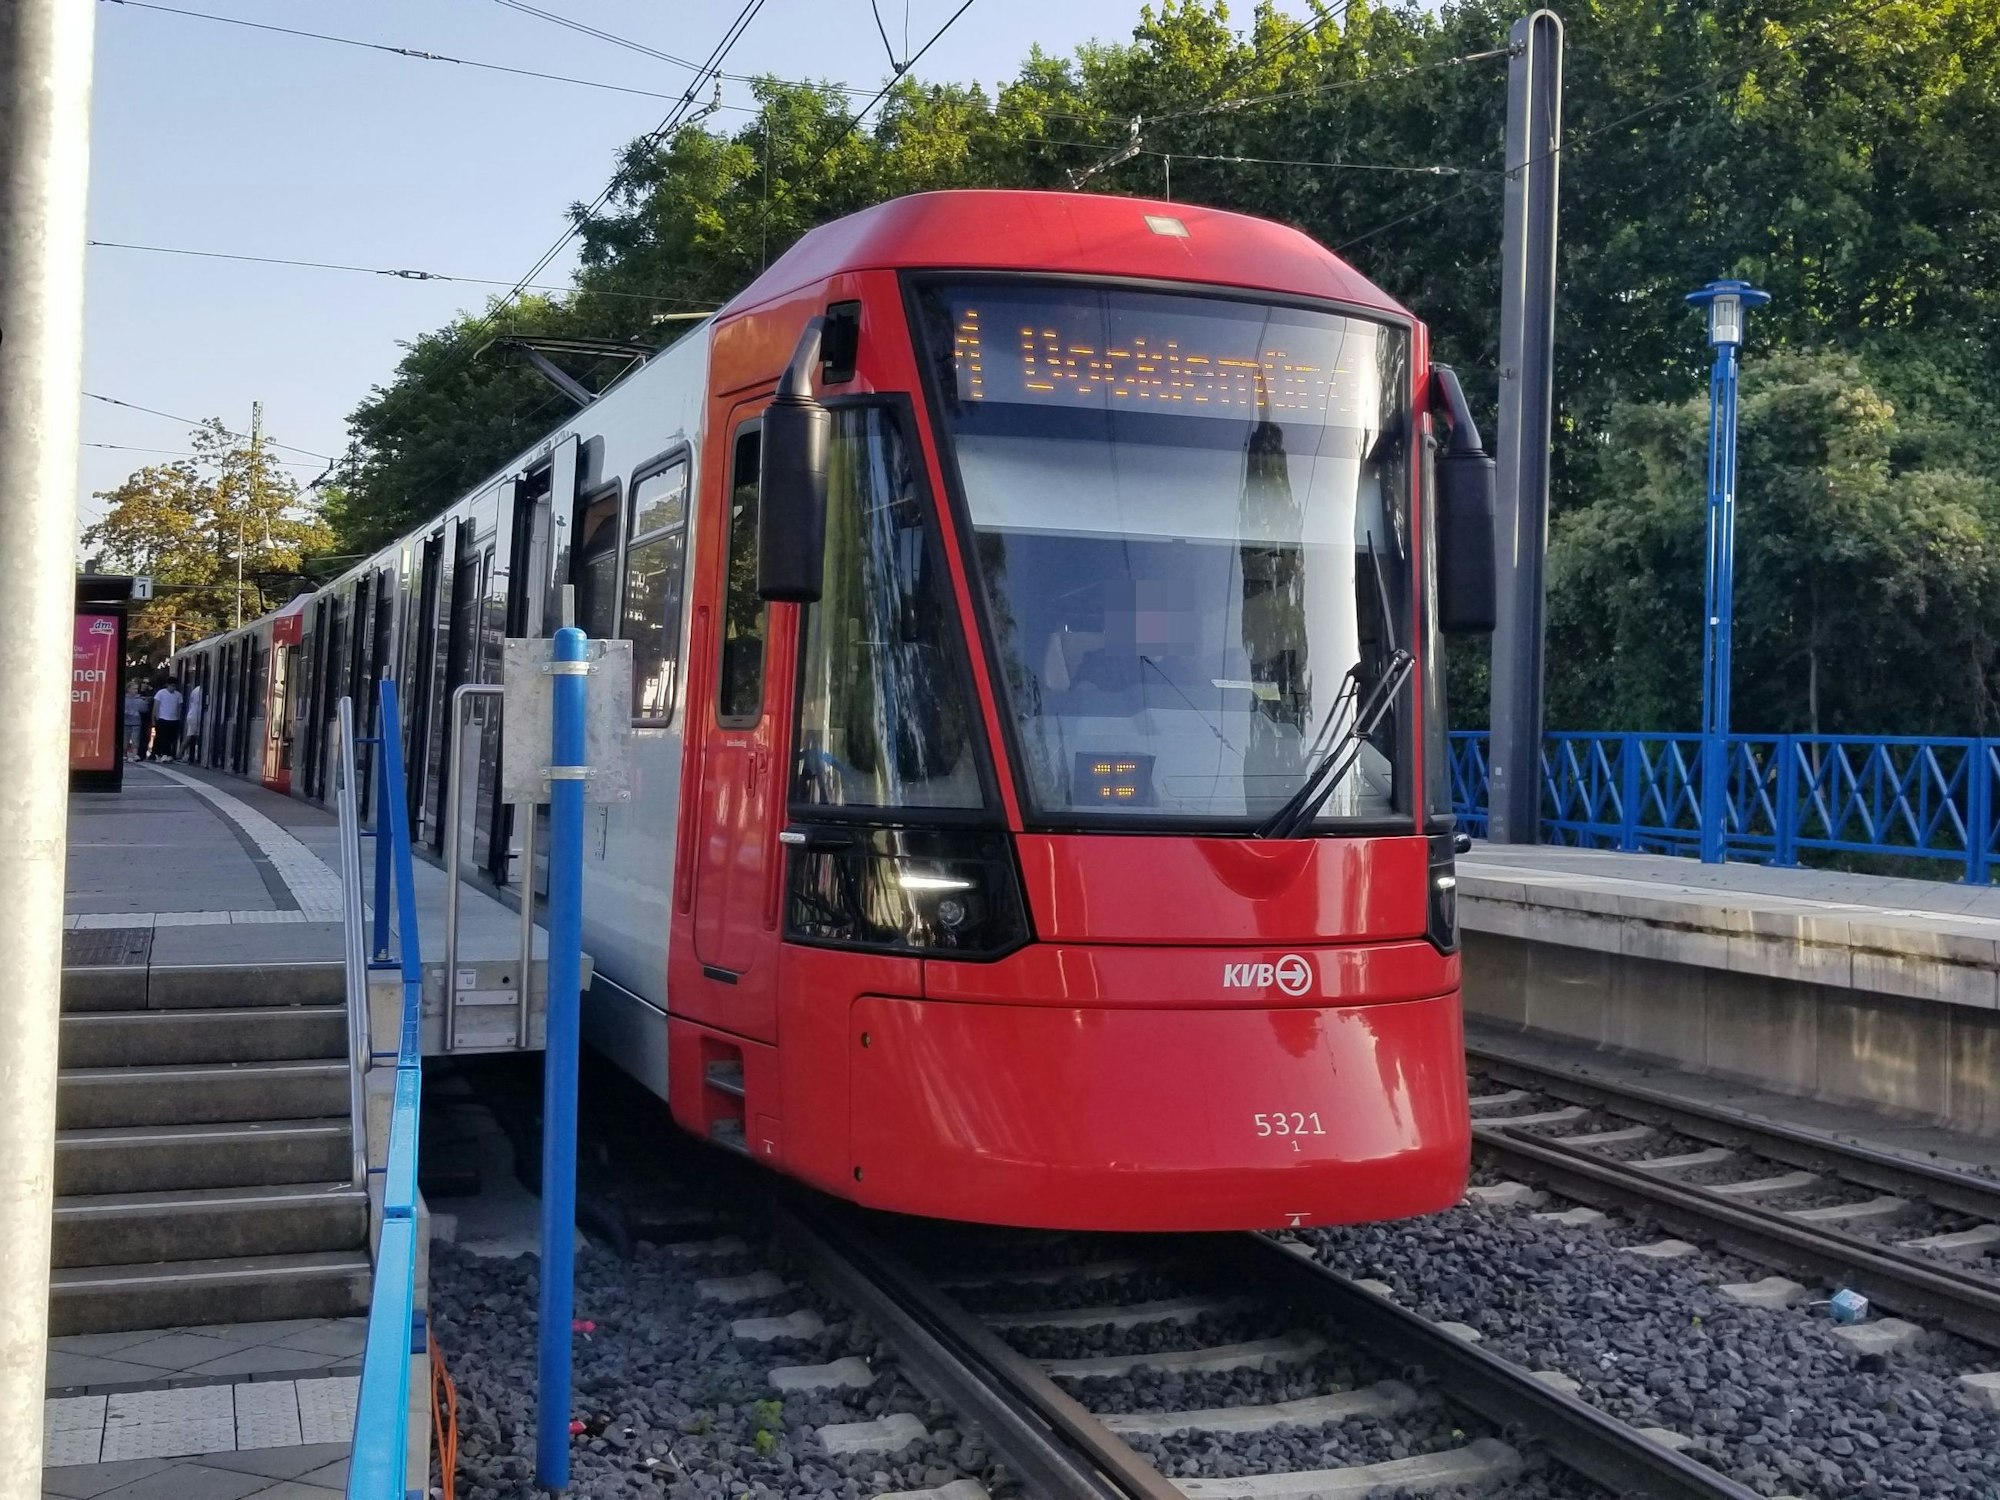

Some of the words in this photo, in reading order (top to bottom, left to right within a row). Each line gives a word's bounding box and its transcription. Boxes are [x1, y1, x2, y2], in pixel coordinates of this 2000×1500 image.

[139, 583, 146, 597] 1
[94, 619, 112, 630] dm
[1223, 963, 1274, 988] KVB
[1254, 1111, 1327, 1137] 5321
[1291, 1140, 1302, 1152] 1
